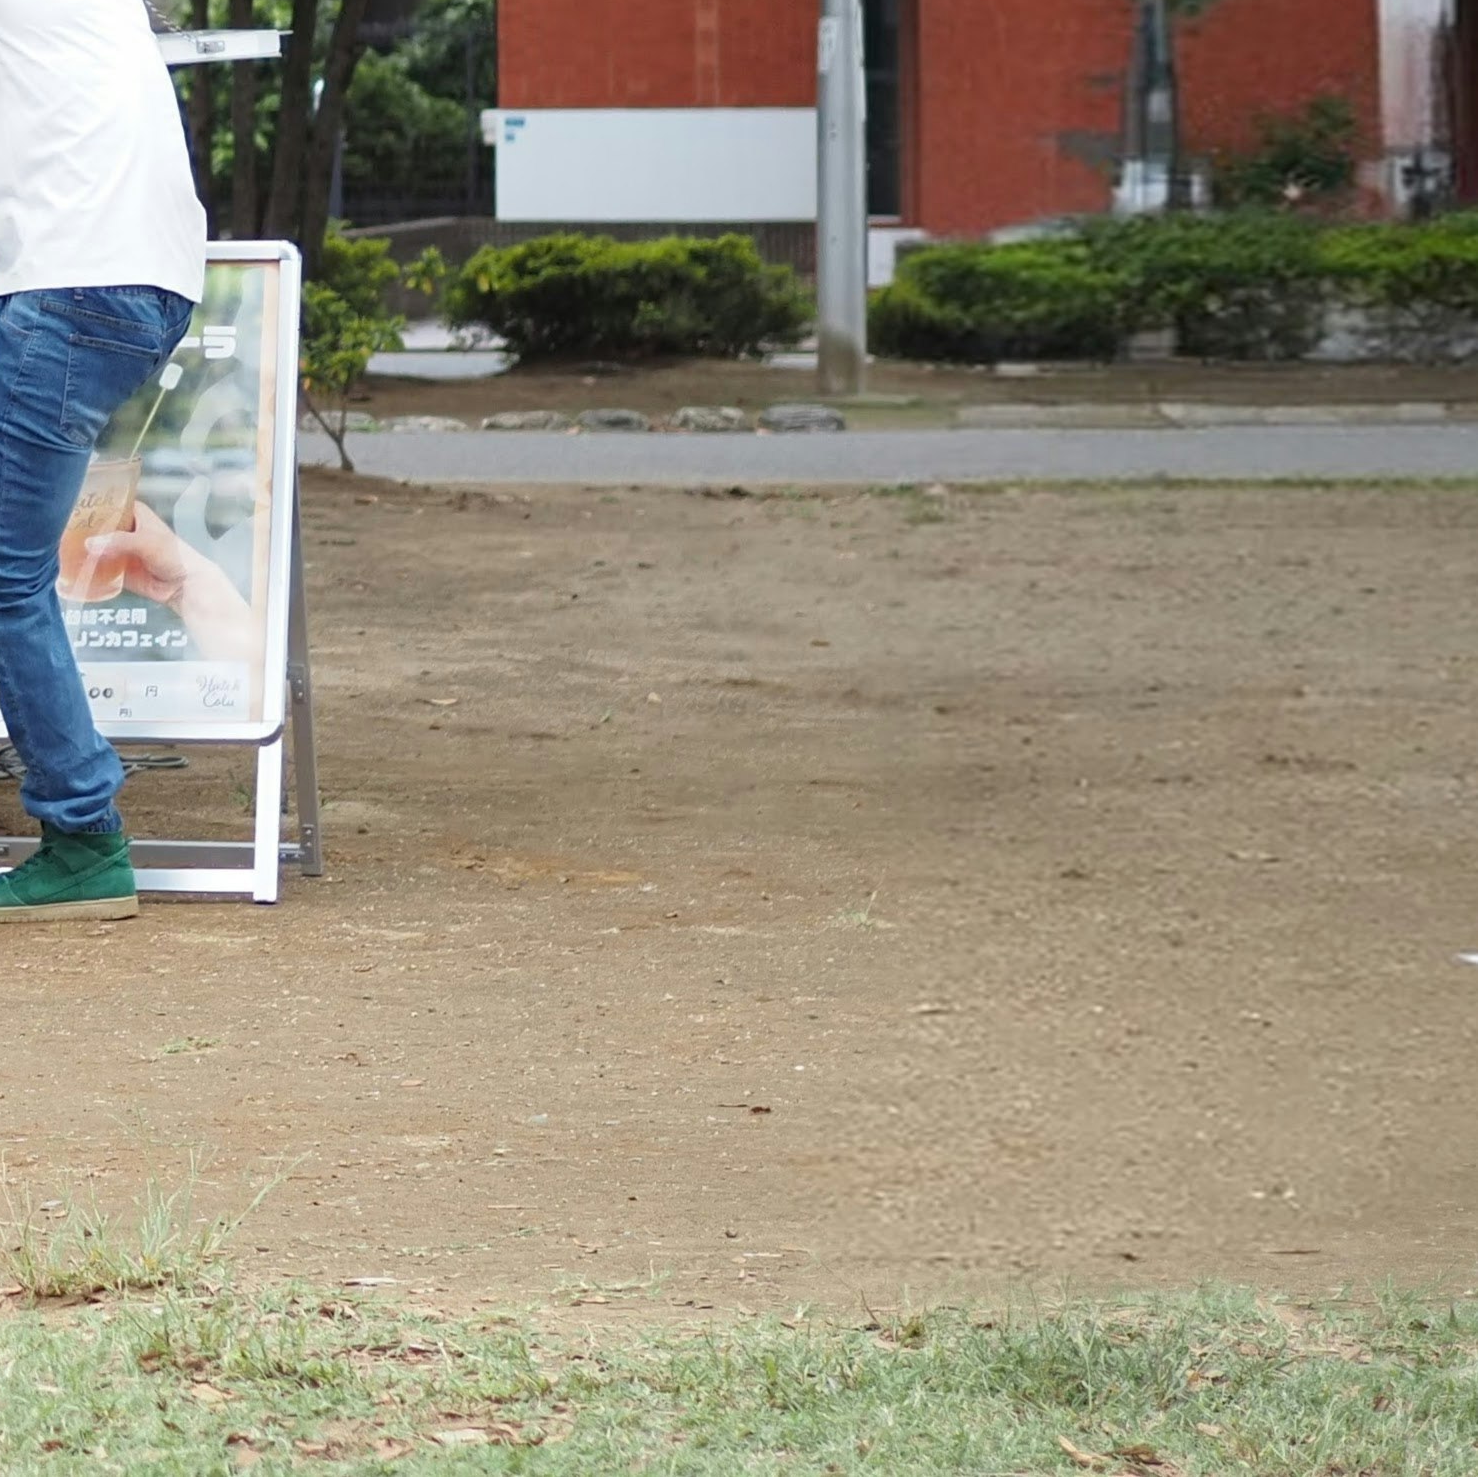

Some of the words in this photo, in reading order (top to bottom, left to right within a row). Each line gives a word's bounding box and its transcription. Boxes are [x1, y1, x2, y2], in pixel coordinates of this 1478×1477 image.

[73, 629, 188, 648] ノンカフェイン
[145, 685, 159, 698] 円
